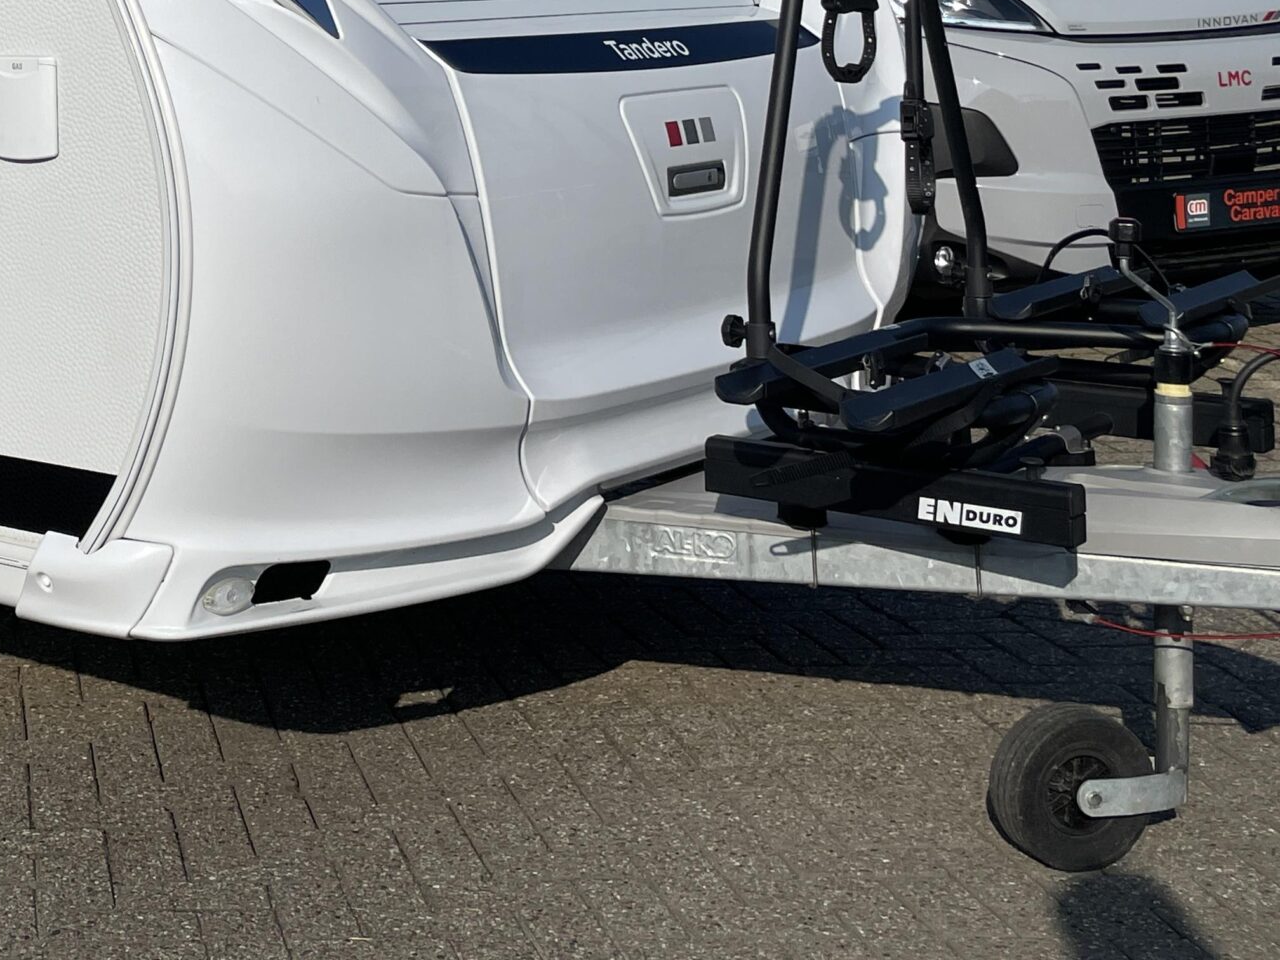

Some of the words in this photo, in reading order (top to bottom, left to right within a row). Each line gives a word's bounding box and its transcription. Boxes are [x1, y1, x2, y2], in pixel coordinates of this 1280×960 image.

[1197, 13, 1259, 28] INNOVAN
[603, 37, 690, 60] Tandero
[1218, 70, 1252, 88] LMC
[918, 497, 1023, 535] ENDURO
